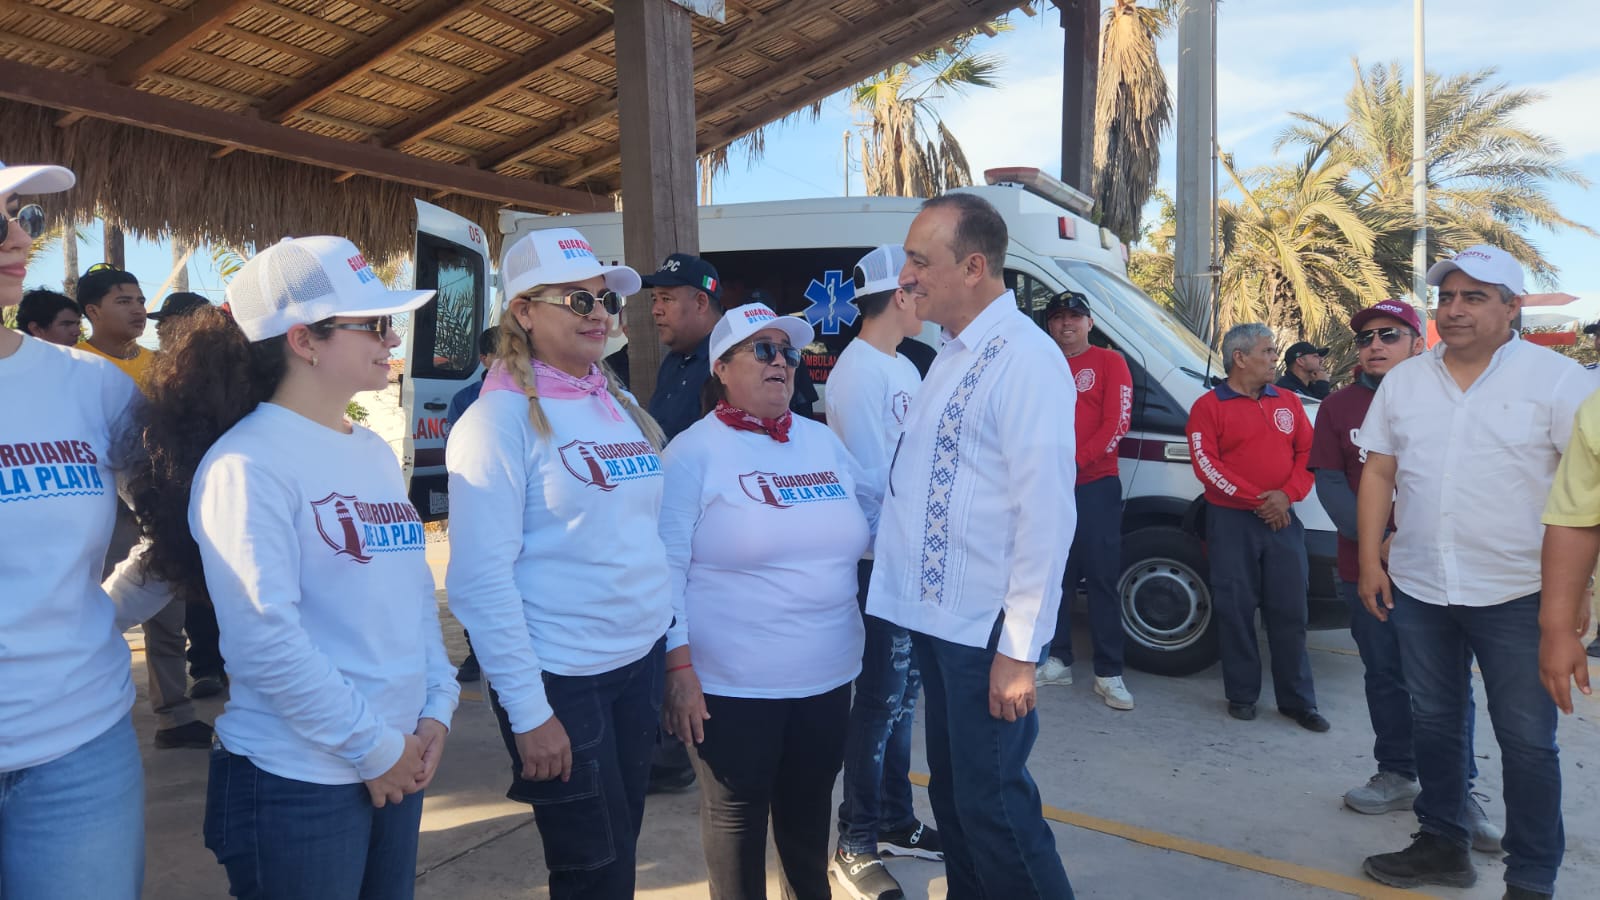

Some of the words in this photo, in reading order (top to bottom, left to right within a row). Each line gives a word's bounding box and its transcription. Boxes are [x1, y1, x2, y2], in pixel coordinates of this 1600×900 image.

[468, 225, 481, 244] 05
[0, 440, 98, 468] RDIANES
[605, 459, 624, 477] DE
[621, 457, 638, 475] LA
[34, 465, 105, 491] PLAYA
[772, 471, 841, 489] GUARDIANES
[779, 488, 798, 501] DE
[797, 486, 816, 500] LA
[374, 525, 391, 547] LA
